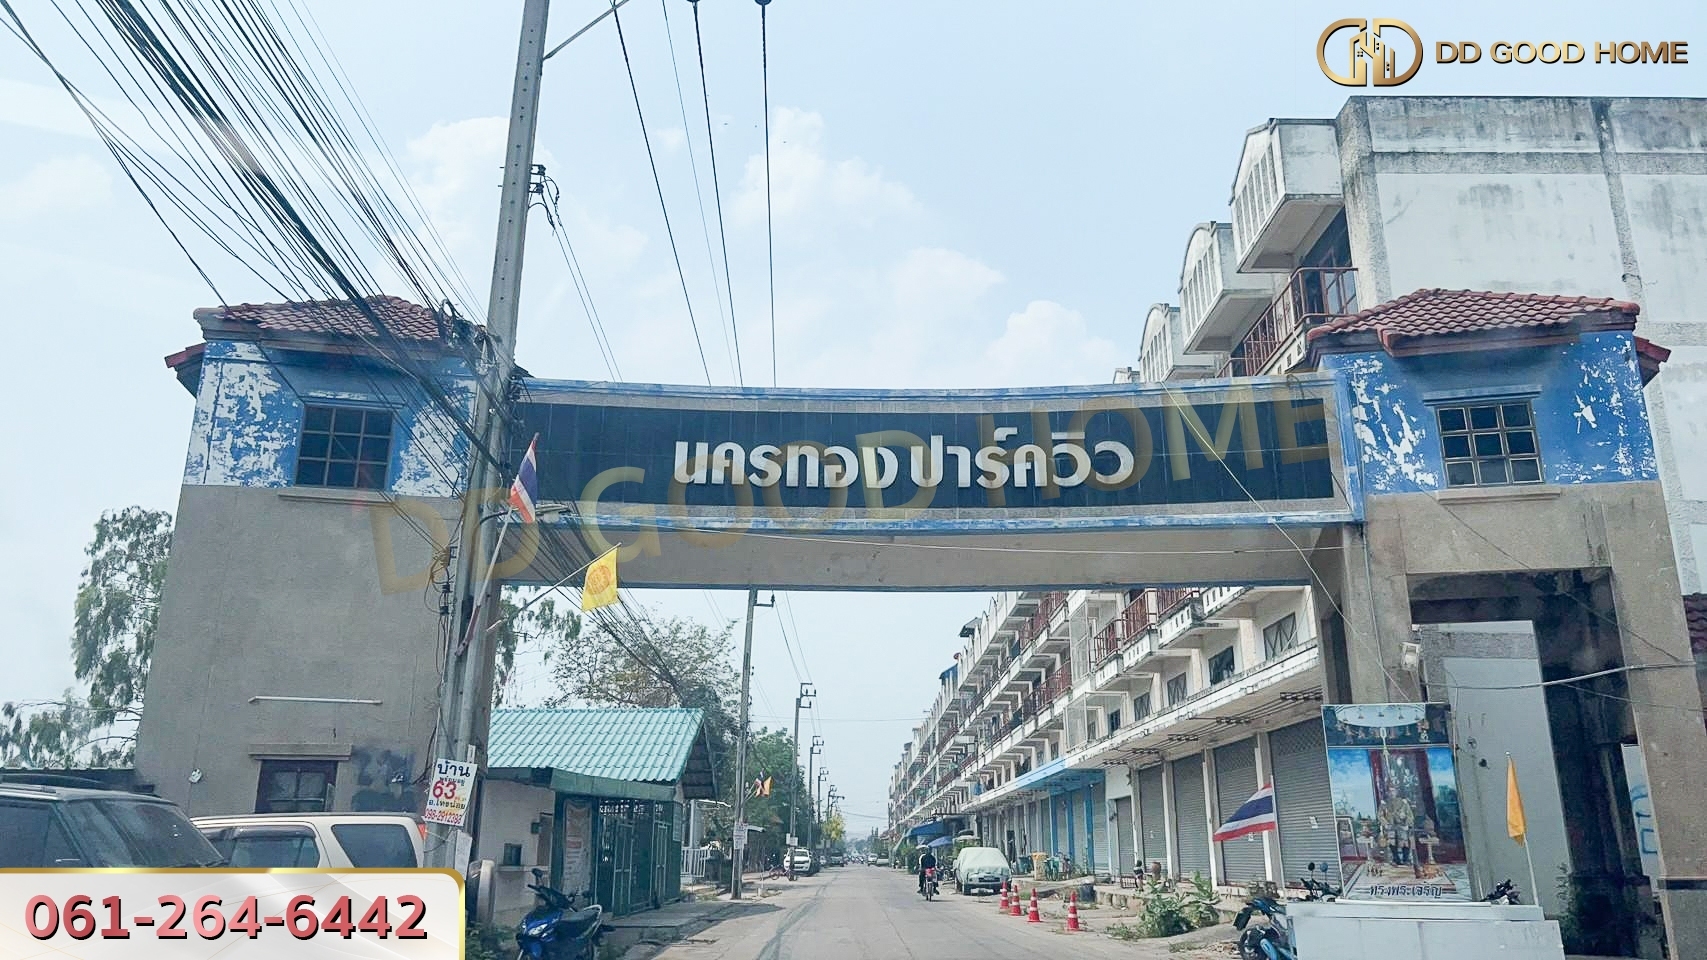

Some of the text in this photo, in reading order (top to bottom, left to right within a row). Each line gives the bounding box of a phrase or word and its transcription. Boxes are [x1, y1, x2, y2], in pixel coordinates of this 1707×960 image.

[437, 760, 471, 777] บ้าน
[433, 780, 457, 799] 63
[1370, 884, 1443, 899] ทรงพระเจริญ
